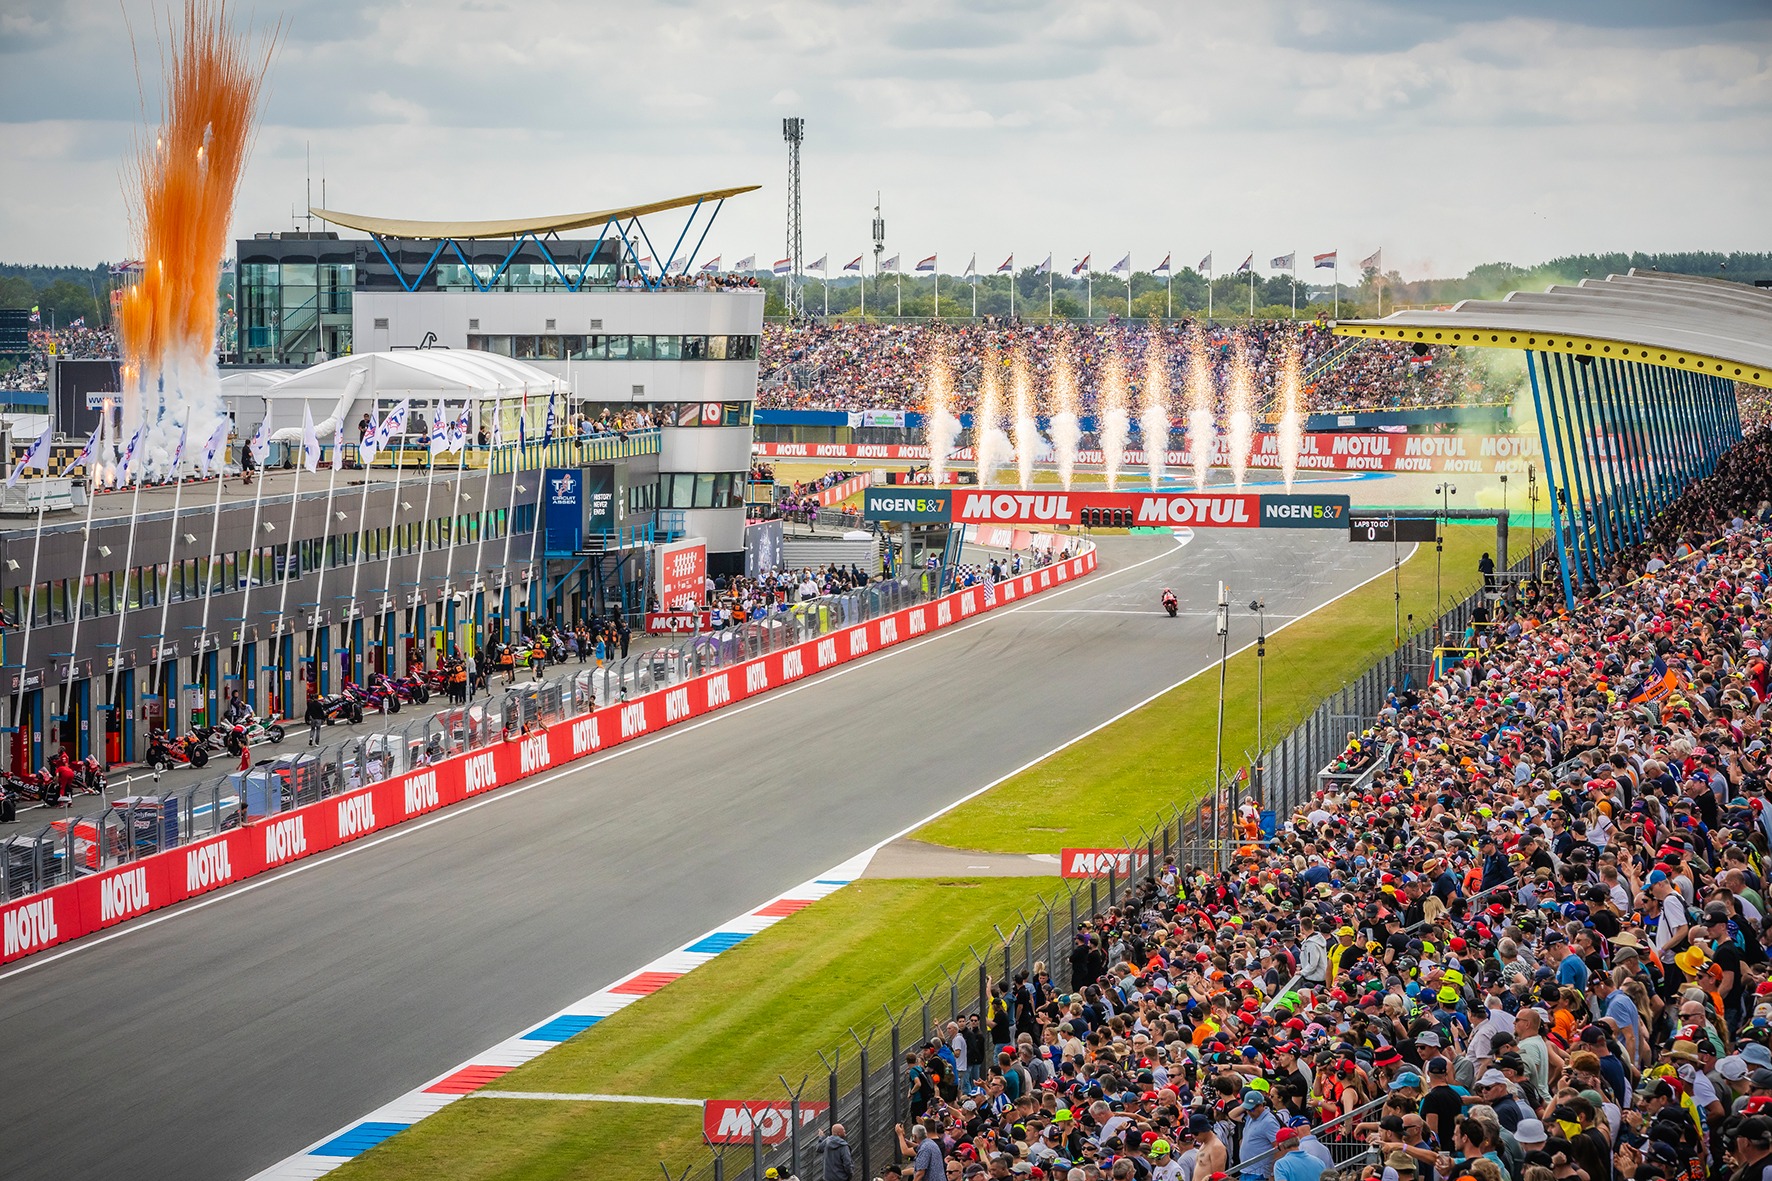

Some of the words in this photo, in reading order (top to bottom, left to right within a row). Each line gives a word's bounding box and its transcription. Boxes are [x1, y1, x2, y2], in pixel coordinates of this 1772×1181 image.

[776, 444, 807, 456] MOTUL
[816, 444, 847, 456] MOTUL
[856, 445, 888, 457] MOTUL
[1332, 436, 1391, 455] MOTUL
[1405, 437, 1466, 456] MOTUL
[1298, 456, 1335, 468] MOTUL
[1346, 456, 1383, 469] MOTUL
[1394, 458, 1432, 470] MOTUL
[1444, 459, 1483, 472] MOTUL
[593, 508, 606, 516] ENDS
[870, 499, 945, 513] NGEN5&7
[962, 494, 1072, 519] MOTUL
[1138, 498, 1250, 523] MOTUL
[1266, 505, 1343, 518] NGEN5&7
[1367, 527, 1376, 540] 0
[880, 617, 898, 645] MOTUL
[909, 608, 926, 634] MOTUL
[818, 638, 837, 667] MOTUL
[850, 627, 868, 655] MOTUL
[746, 661, 768, 693] MOTUL
[783, 649, 804, 680] MOTUL
[666, 687, 690, 722] MOTUL
[707, 674, 731, 707] MOTUL
[621, 702, 647, 738] MOTUL
[573, 717, 600, 754] MOTUL
[520, 733, 550, 773] MOTUL
[465, 751, 496, 793] MOTUL
[404, 770, 439, 814] MOTUL
[338, 792, 375, 838] MOTUL
[266, 815, 307, 864] MOTUL
[186, 839, 232, 892] MOTUL
[101, 866, 149, 922] MOTUL
[4, 897, 57, 957] MOTUL
